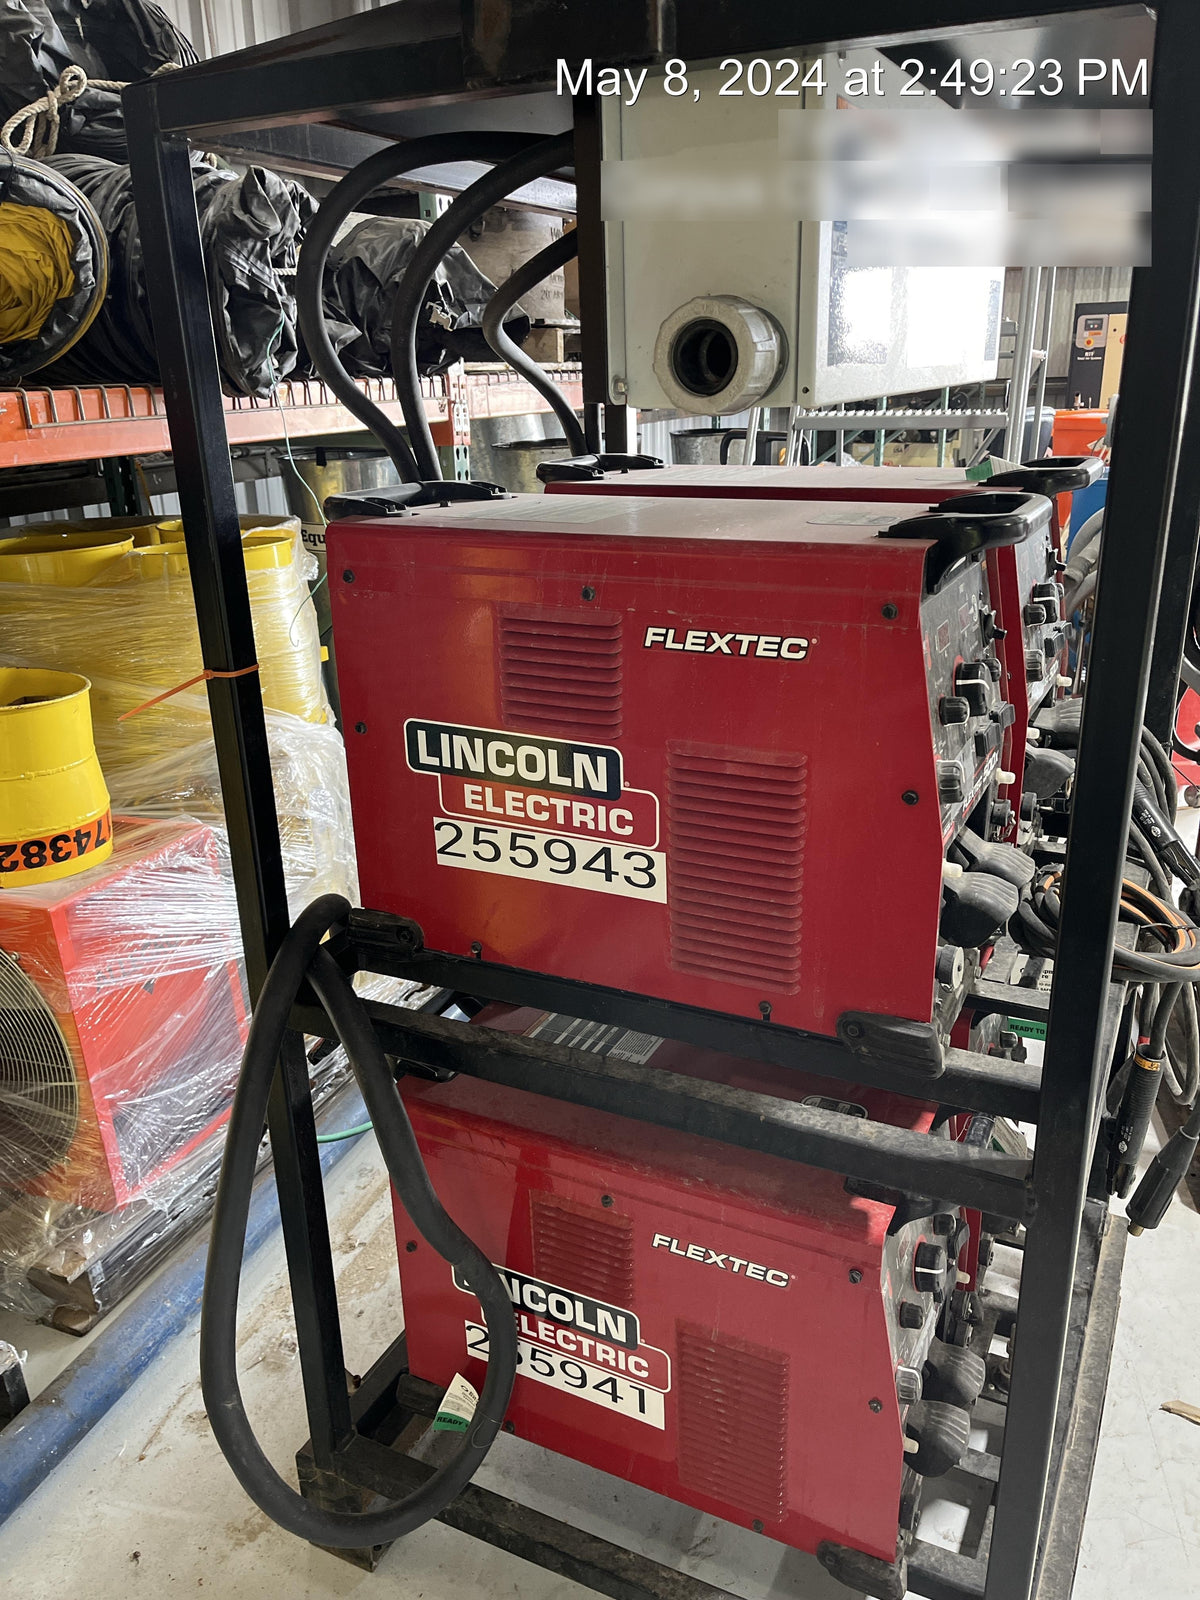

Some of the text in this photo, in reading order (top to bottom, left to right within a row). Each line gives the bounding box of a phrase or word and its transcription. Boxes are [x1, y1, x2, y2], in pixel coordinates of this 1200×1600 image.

[644, 626, 809, 661] FLEXTEC
[417, 729, 608, 793] LINCOLN
[463, 783, 634, 836] ELECTRIC
[434, 821, 657, 889] 255943
[1010, 1023, 1034, 1033] READY
[652, 1233, 789, 1287] FLEXTEC
[464, 1273, 627, 1344] NCOLN
[465, 1324, 646, 1415] 25941
[436, 1416, 463, 1426] READY
